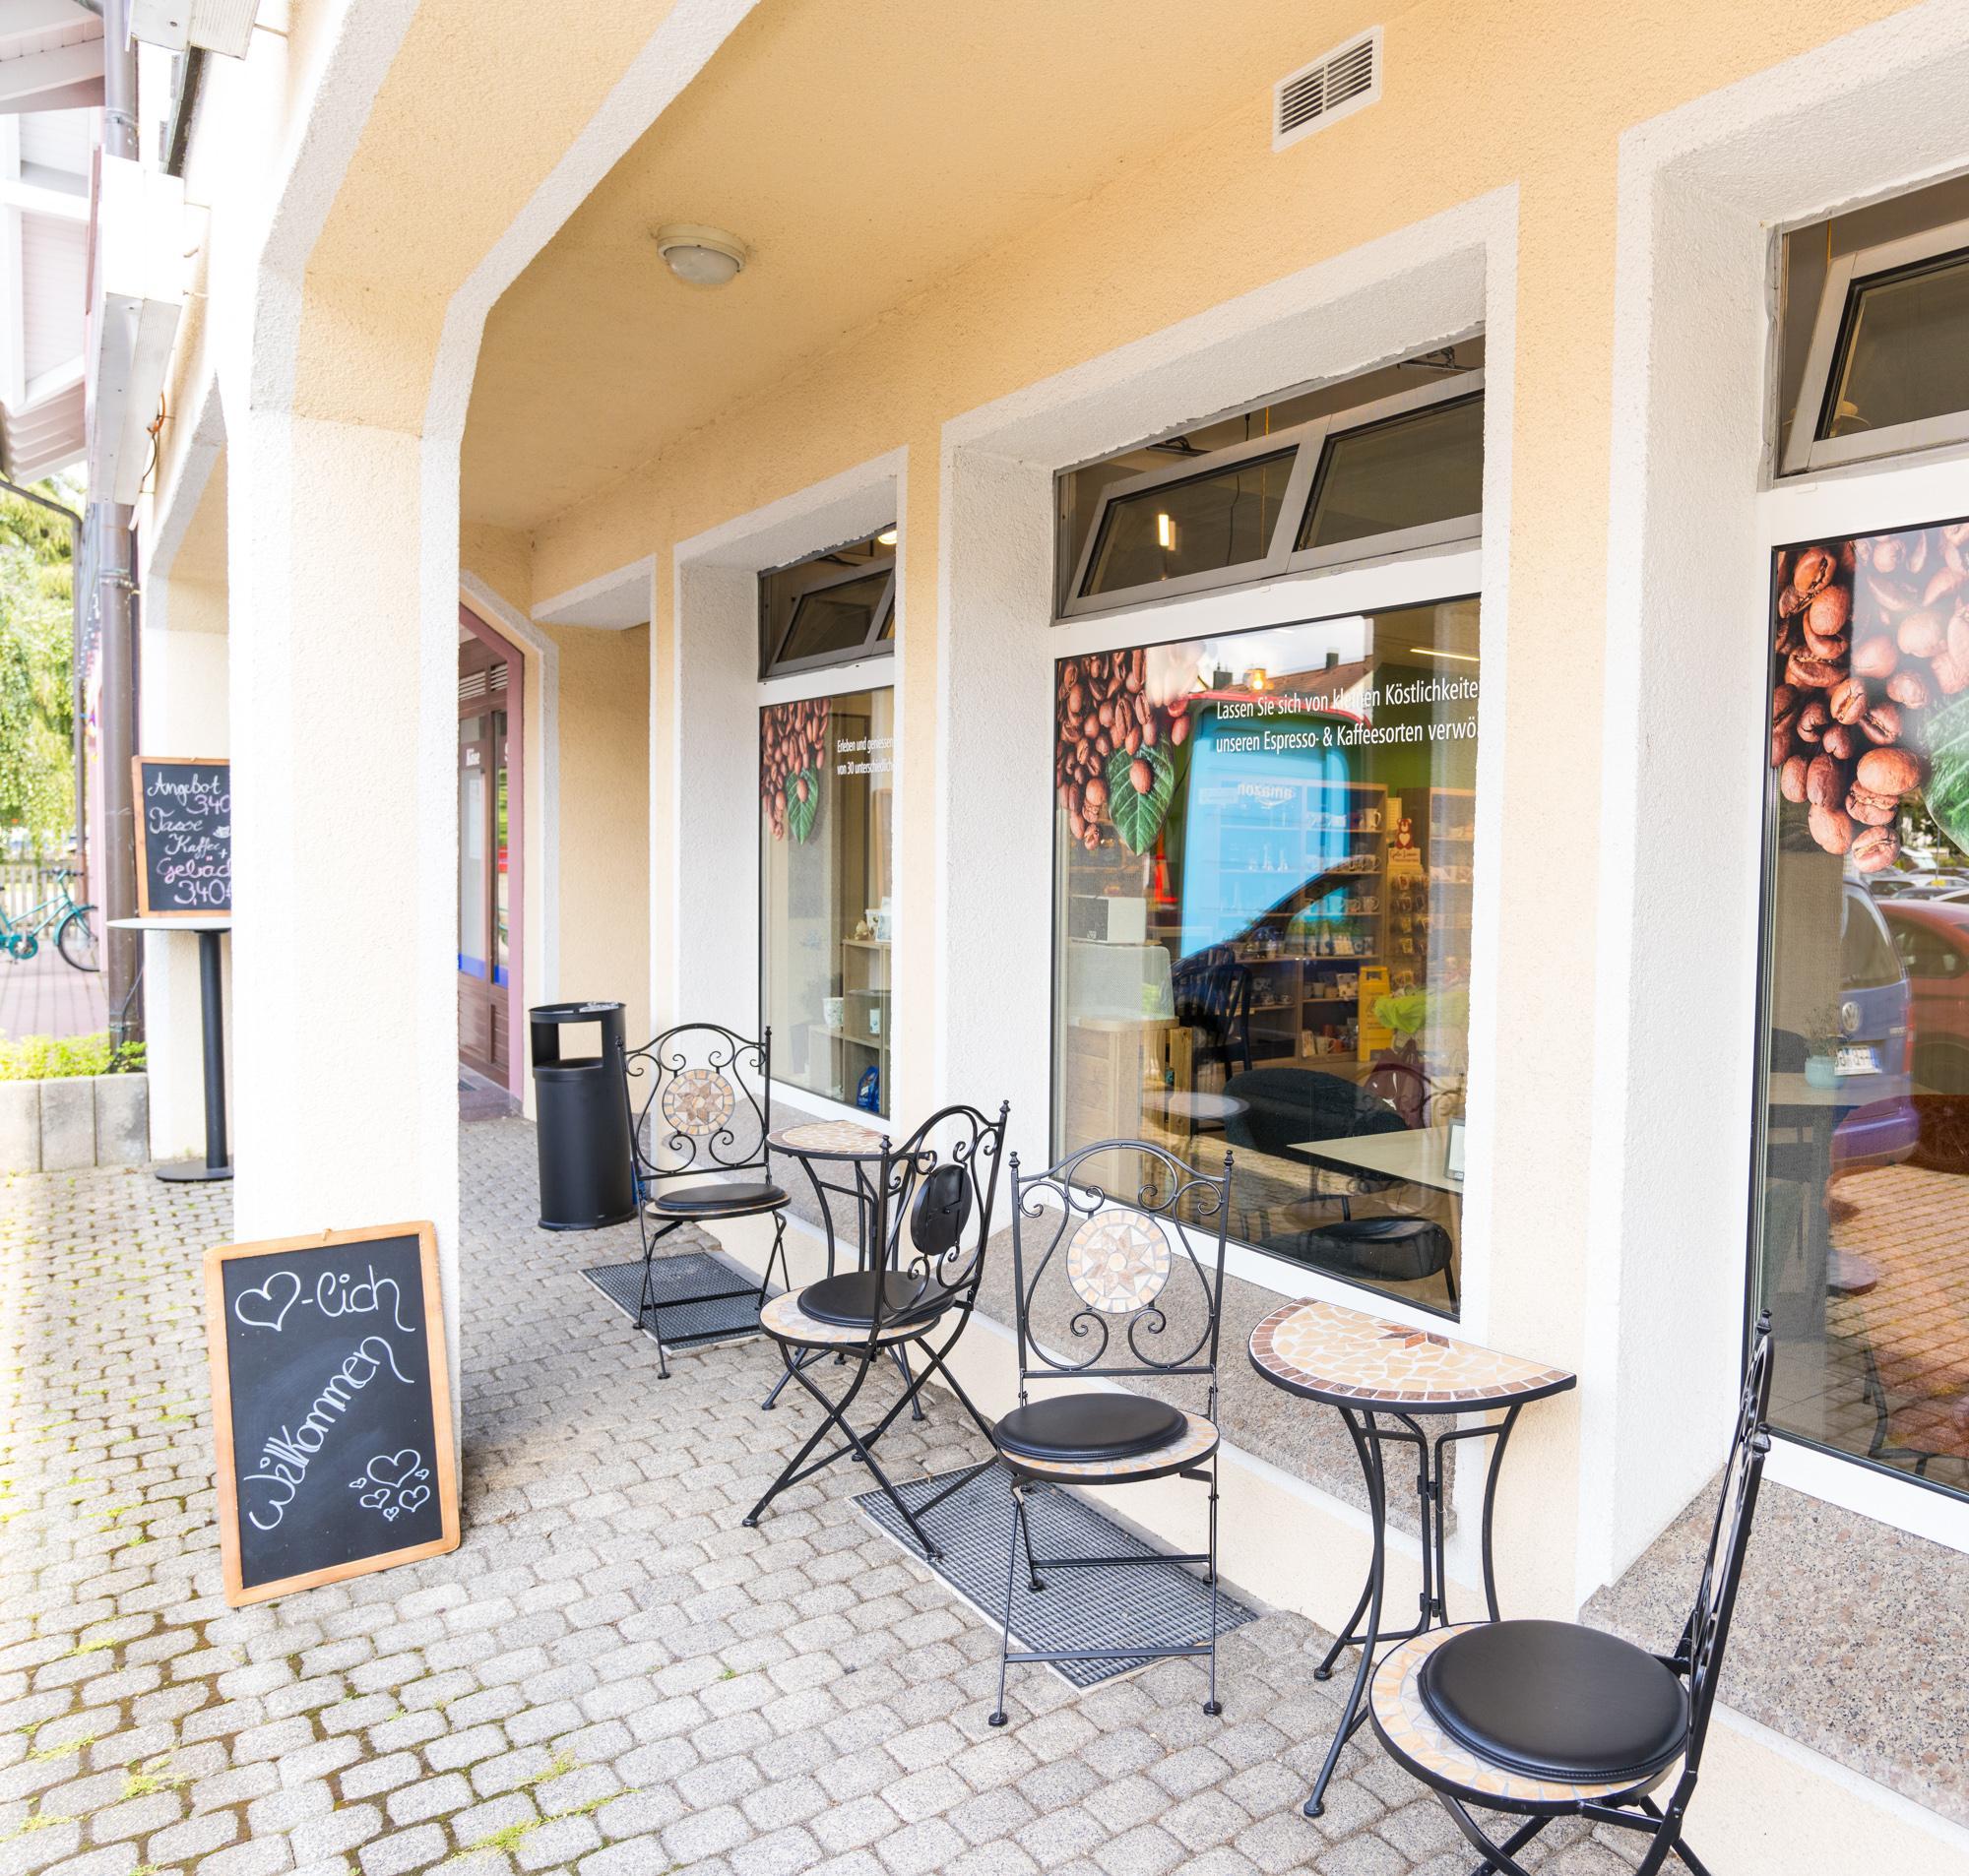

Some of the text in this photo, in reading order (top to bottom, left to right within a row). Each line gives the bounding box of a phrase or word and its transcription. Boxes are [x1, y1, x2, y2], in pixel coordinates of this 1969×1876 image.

[1217, 702, 1253, 719] Lassen
[1257, 696, 1274, 717] Sie
[1278, 692, 1301, 715] sich
[1304, 694, 1328, 712] von
[837, 738, 857, 753] Erleben
[857, 736, 866, 751] und
[1216, 735, 1260, 753] unseren
[1264, 730, 1319, 755] Espresso-
[1322, 725, 1333, 746] &
[1337, 721, 1423, 746] Kaffeesorten
[837, 765, 847, 776] von
[848, 761, 855, 775] 30
[147, 771, 222, 806] Angebot
[149, 806, 204, 835] Tasse
[164, 832, 222, 859] Kaffee
[243, 1336, 414, 1531] Willkommen
